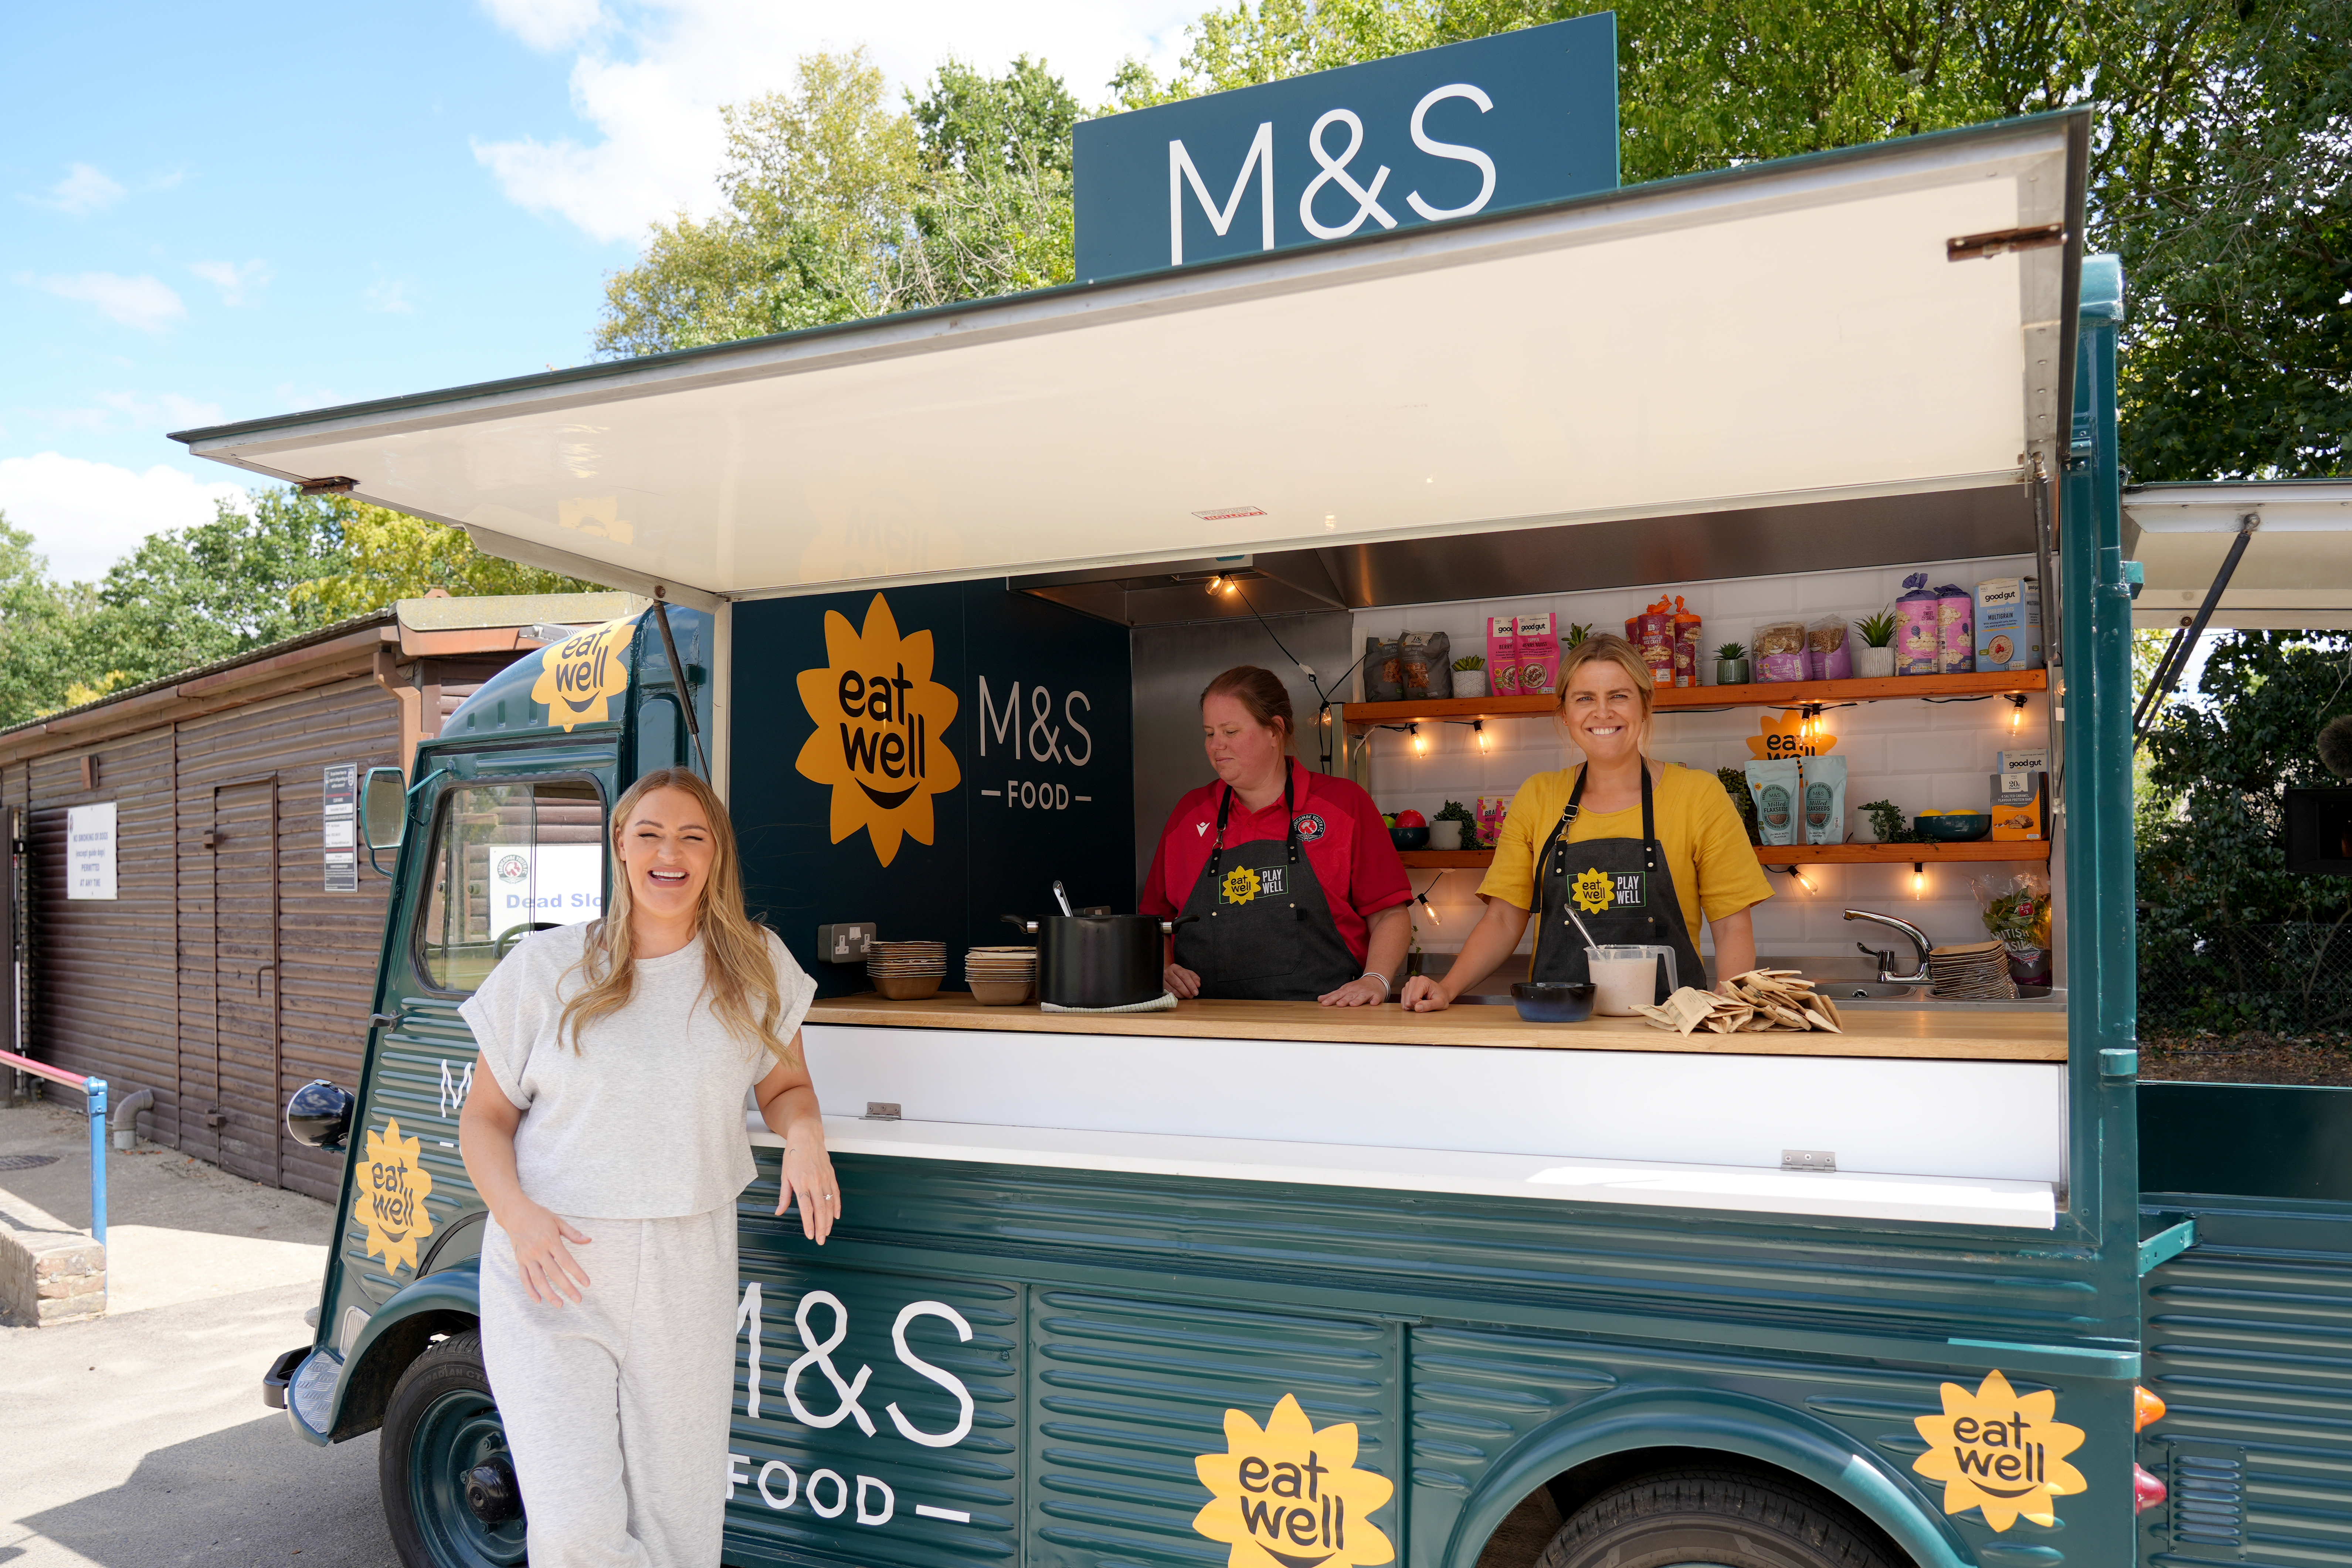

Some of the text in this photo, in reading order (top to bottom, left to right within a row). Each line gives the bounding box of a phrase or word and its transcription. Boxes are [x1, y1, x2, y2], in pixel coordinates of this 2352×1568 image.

[1169, 84, 1496, 266] M&S
[1985, 591, 2015, 602] good gut
[1521, 623, 1535, 631] good
[562, 625, 613, 659] eat
[556, 645, 608, 692] well
[839, 662, 913, 725] eat
[979, 675, 1092, 766] M&S
[841, 713, 925, 778] well
[2009, 759, 2042, 768] good gut
[1008, 780, 1069, 810] FOOD
[1762, 787, 1771, 800] VERSATILE
[1776, 786, 1789, 799] DELICIOUS
[1822, 784, 1832, 798] DELICIOUS
[1313, 815, 1323, 827] YOUTH
[1764, 815, 1780, 829] INGREDIENTS
[79, 832, 94, 842] SMOKING
[99, 831, 108, 841] DOGS
[516, 856, 527, 868] YOUTH
[1231, 875, 1248, 885] eat
[1262, 869, 1282, 882] PLAY
[80, 879, 84, 887] AT
[1231, 881, 1251, 893] well
[1262, 880, 1283, 895] WELL
[1582, 879, 1602, 890] eat
[1617, 876, 1639, 890] PLAY
[1583, 887, 1605, 899] well
[1616, 890, 1640, 904] WELL
[507, 893, 602, 908] Dead Slo
[1990, 928, 2030, 940] BRITISH
[2003, 940, 2026, 952] ASIL
[372, 1157, 408, 1194] eat
[372, 1187, 413, 1227] well
[1954, 1411, 2031, 1449] eat
[1954, 1442, 2044, 1483] well
[1239, 1450, 1329, 1503] eat
[726, 1453, 895, 1526] FOOD
[1240, 1493, 1344, 1550] well
